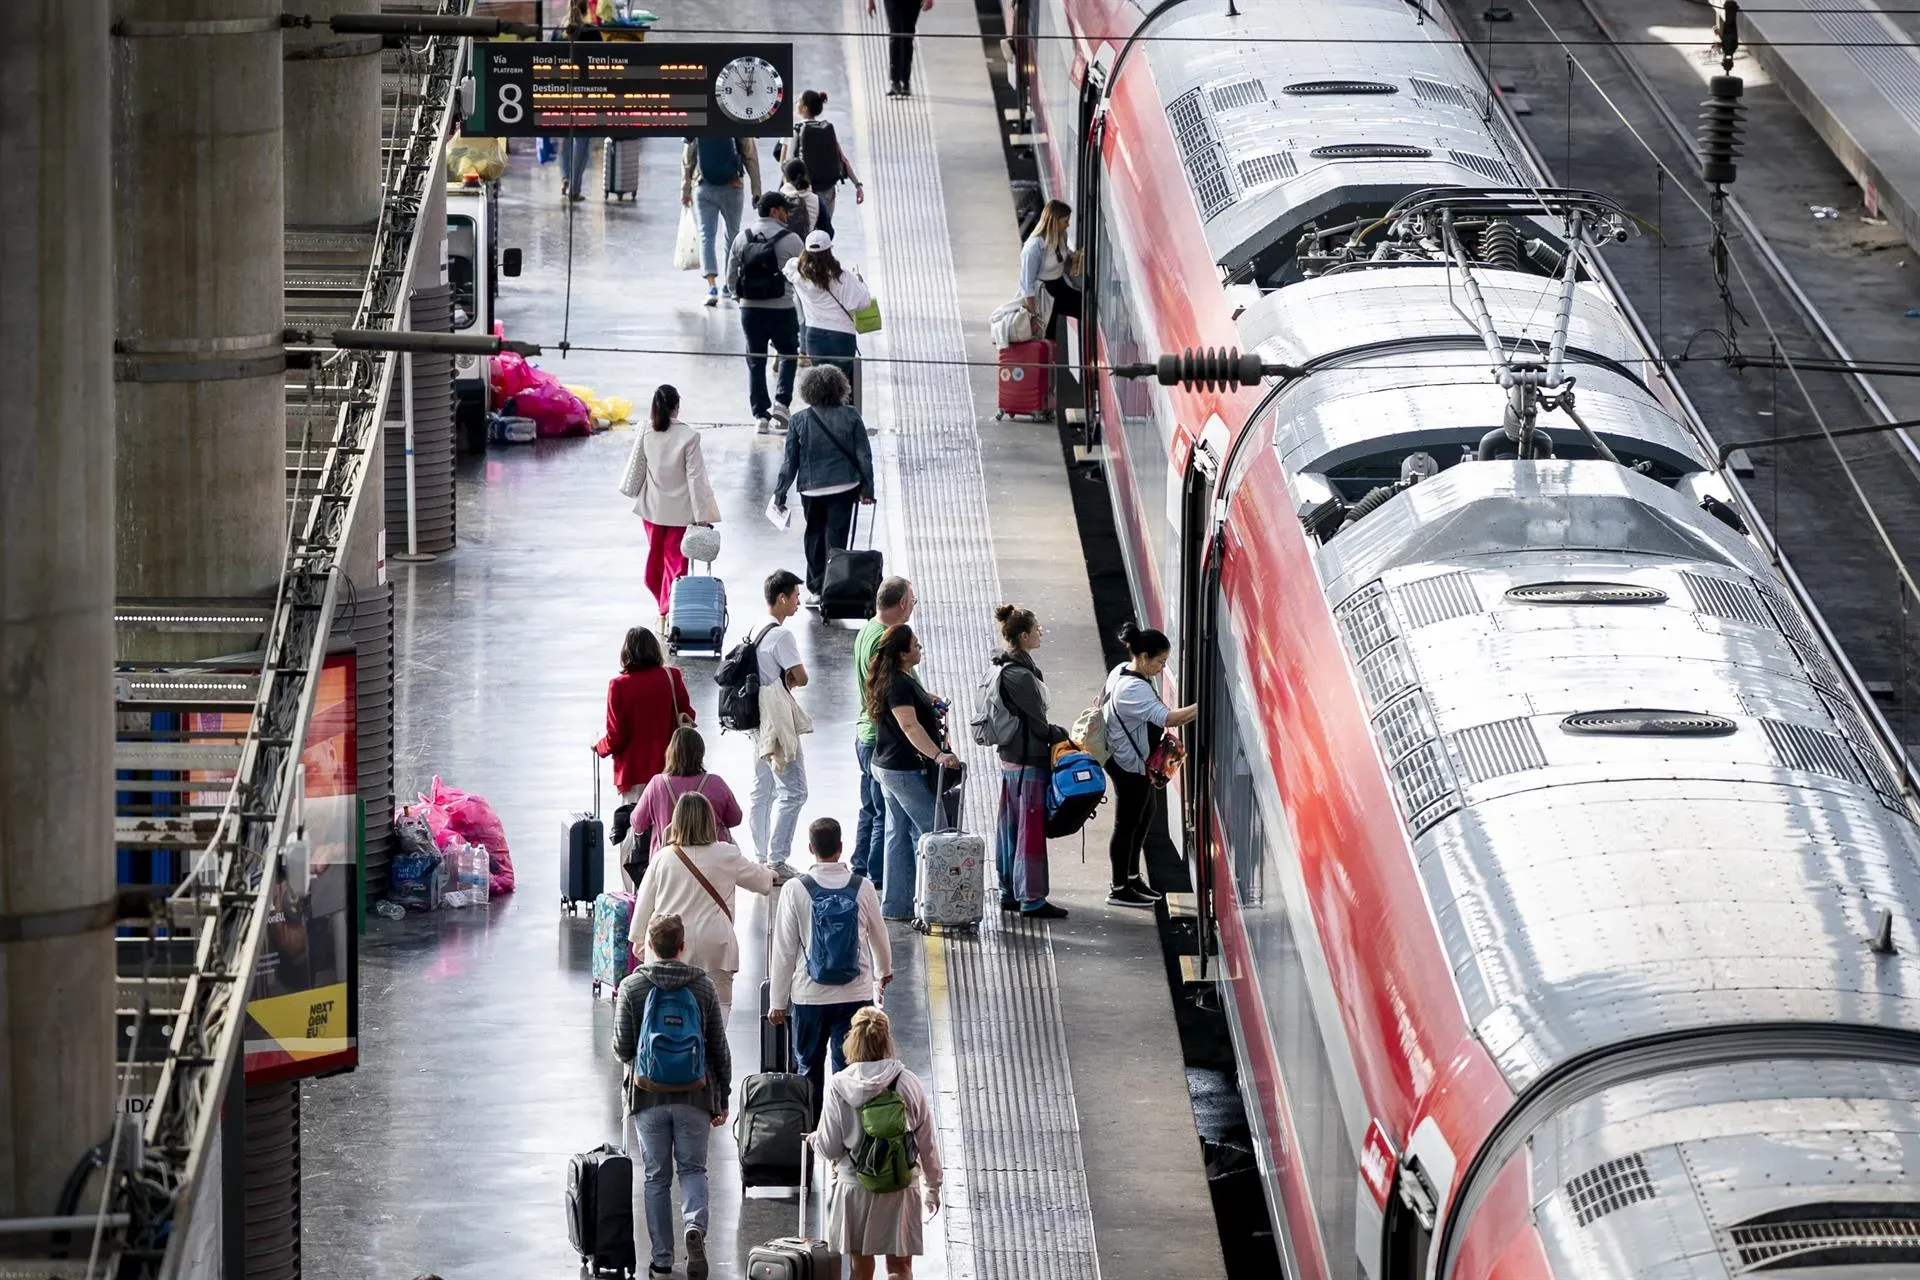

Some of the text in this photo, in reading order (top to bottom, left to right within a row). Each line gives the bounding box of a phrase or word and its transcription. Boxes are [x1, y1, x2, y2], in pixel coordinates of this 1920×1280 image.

[493, 54, 507, 64] Vía
[532, 55, 553, 64] Hora
[587, 55, 606, 64] Tren
[532, 84, 566, 93] Destino
[766, 86, 773, 95] 3
[498, 83, 523, 124] 8
[745, 107, 753, 115] 6
